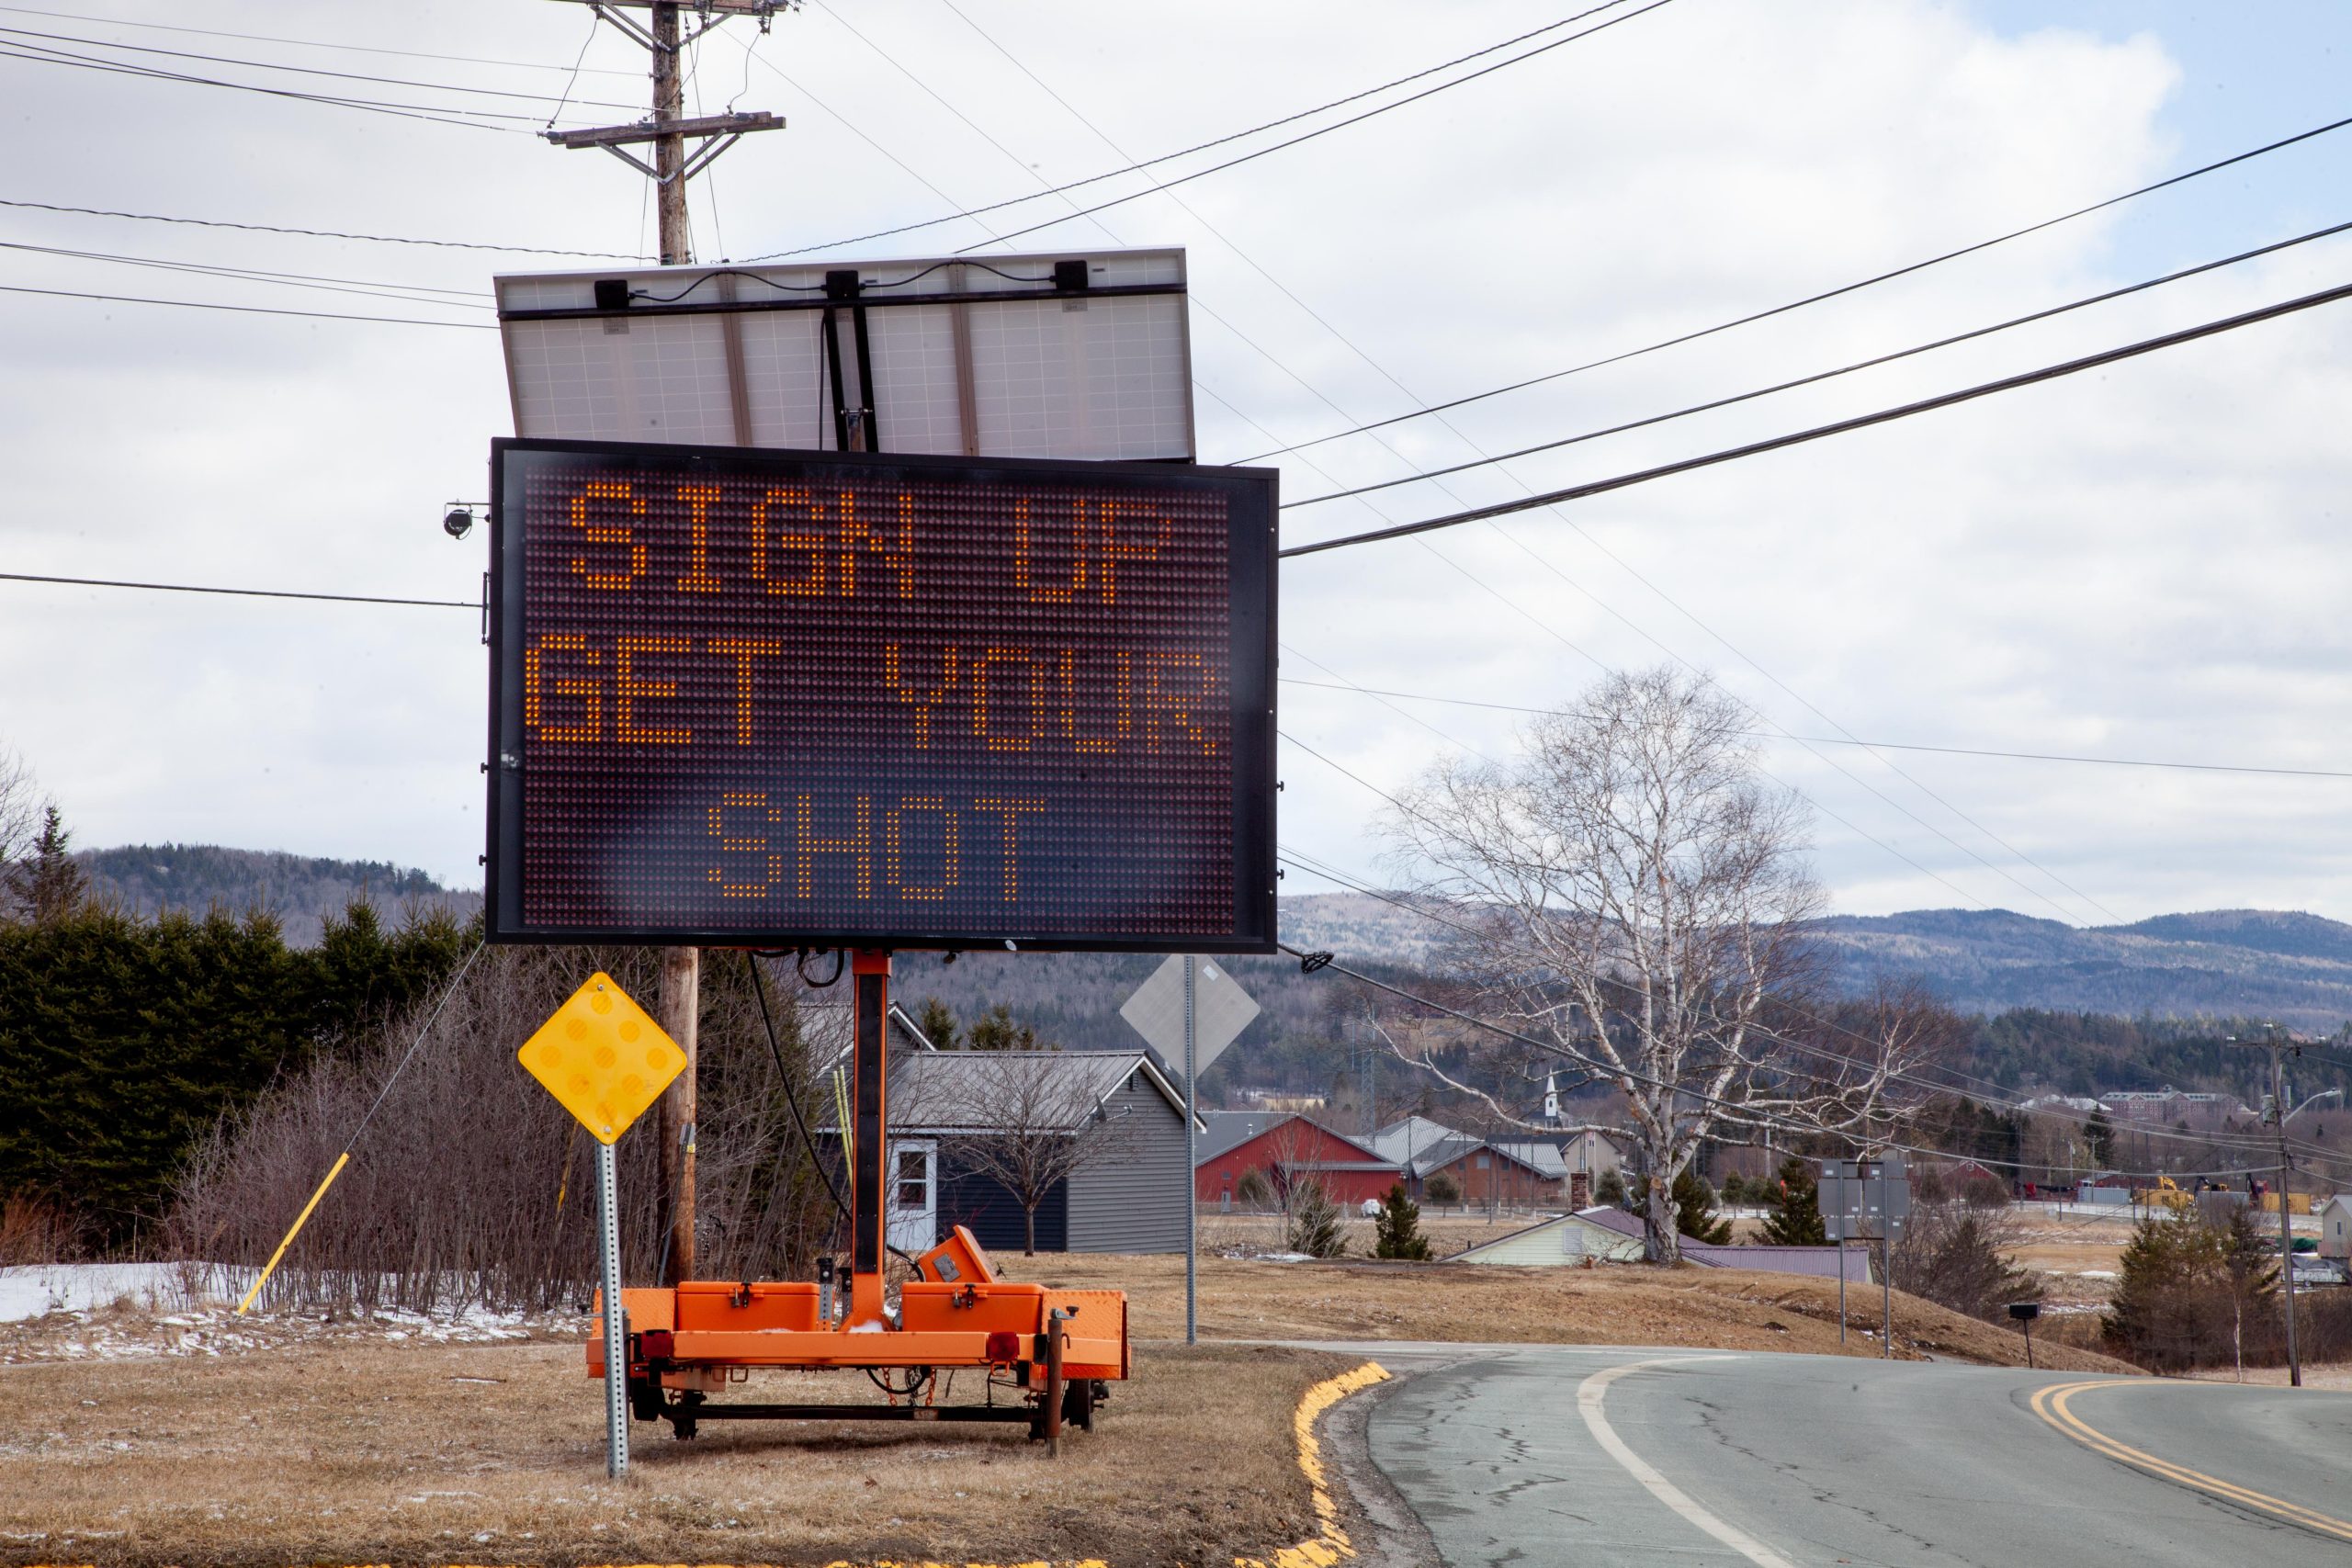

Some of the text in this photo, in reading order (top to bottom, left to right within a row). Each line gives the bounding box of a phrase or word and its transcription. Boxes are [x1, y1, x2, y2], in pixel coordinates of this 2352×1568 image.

[571, 482, 1172, 604] SIGN UP
[526, 634, 1216, 756] GET YOUR
[708, 793, 1046, 901] SHOT
